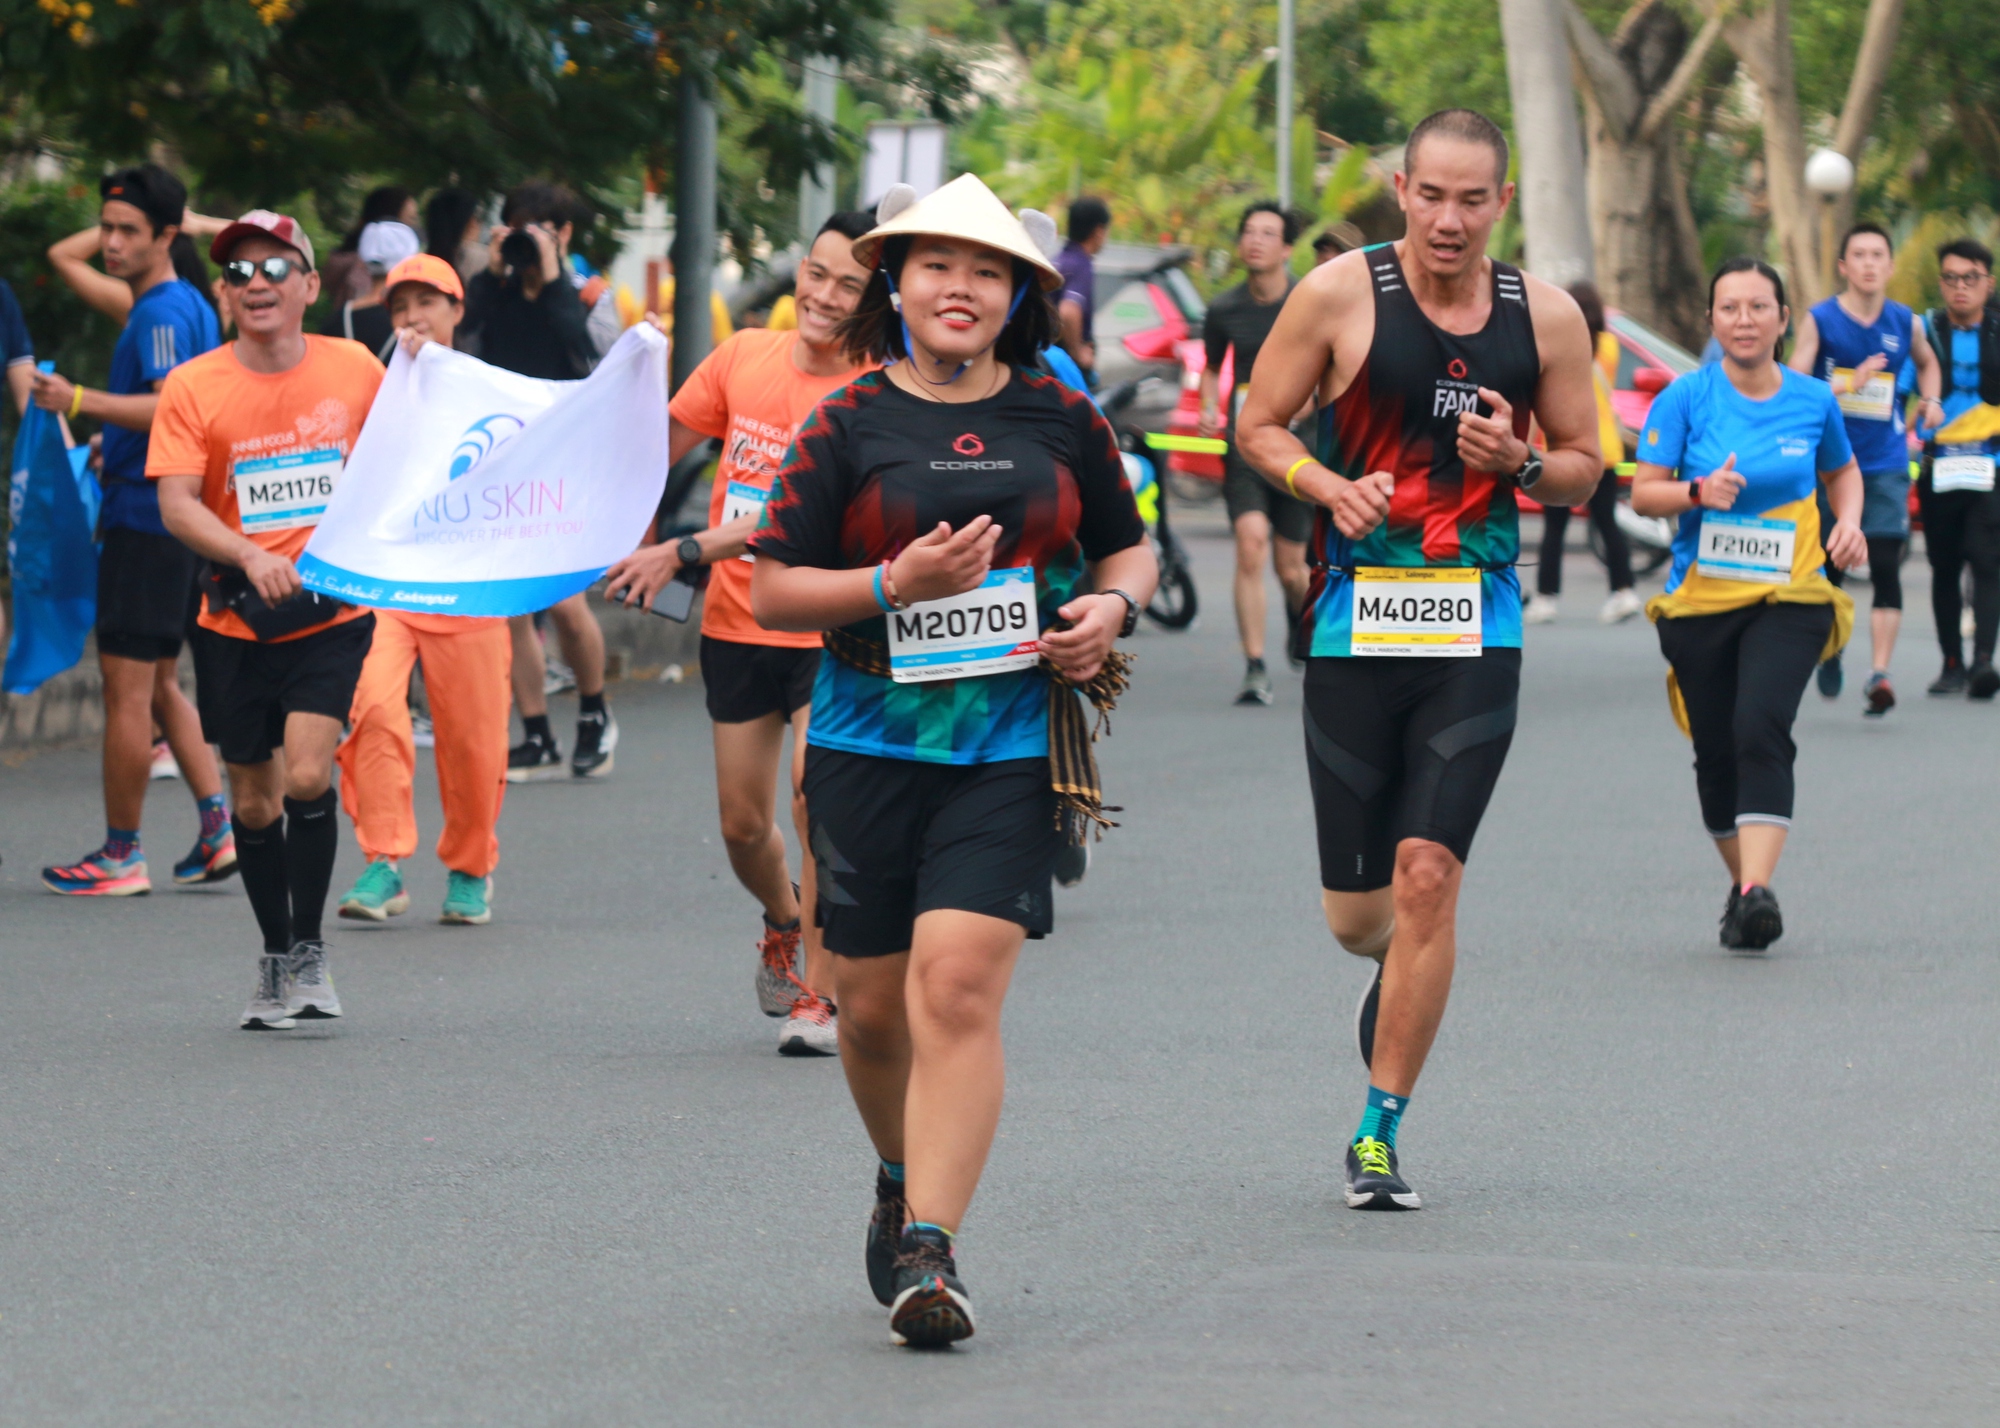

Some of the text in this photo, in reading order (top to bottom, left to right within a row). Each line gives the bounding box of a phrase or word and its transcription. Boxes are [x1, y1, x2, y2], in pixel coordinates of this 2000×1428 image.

[1435, 379, 1479, 390] COROS
[1433, 388, 1479, 418] FAM
[263, 430, 296, 447] FOCUS
[929, 460, 1015, 471] COROS
[249, 474, 333, 506] M21176
[413, 477, 564, 529] NU SKIN
[415, 519, 584, 546] DISCOVER THE BEST YOU
[1712, 533, 1781, 559] F21021
[1404, 570, 1436, 579] Salonpas
[894, 601, 1027, 643] M20709
[1358, 597, 1473, 622] M40280
[925, 666, 964, 677] MARATHON
